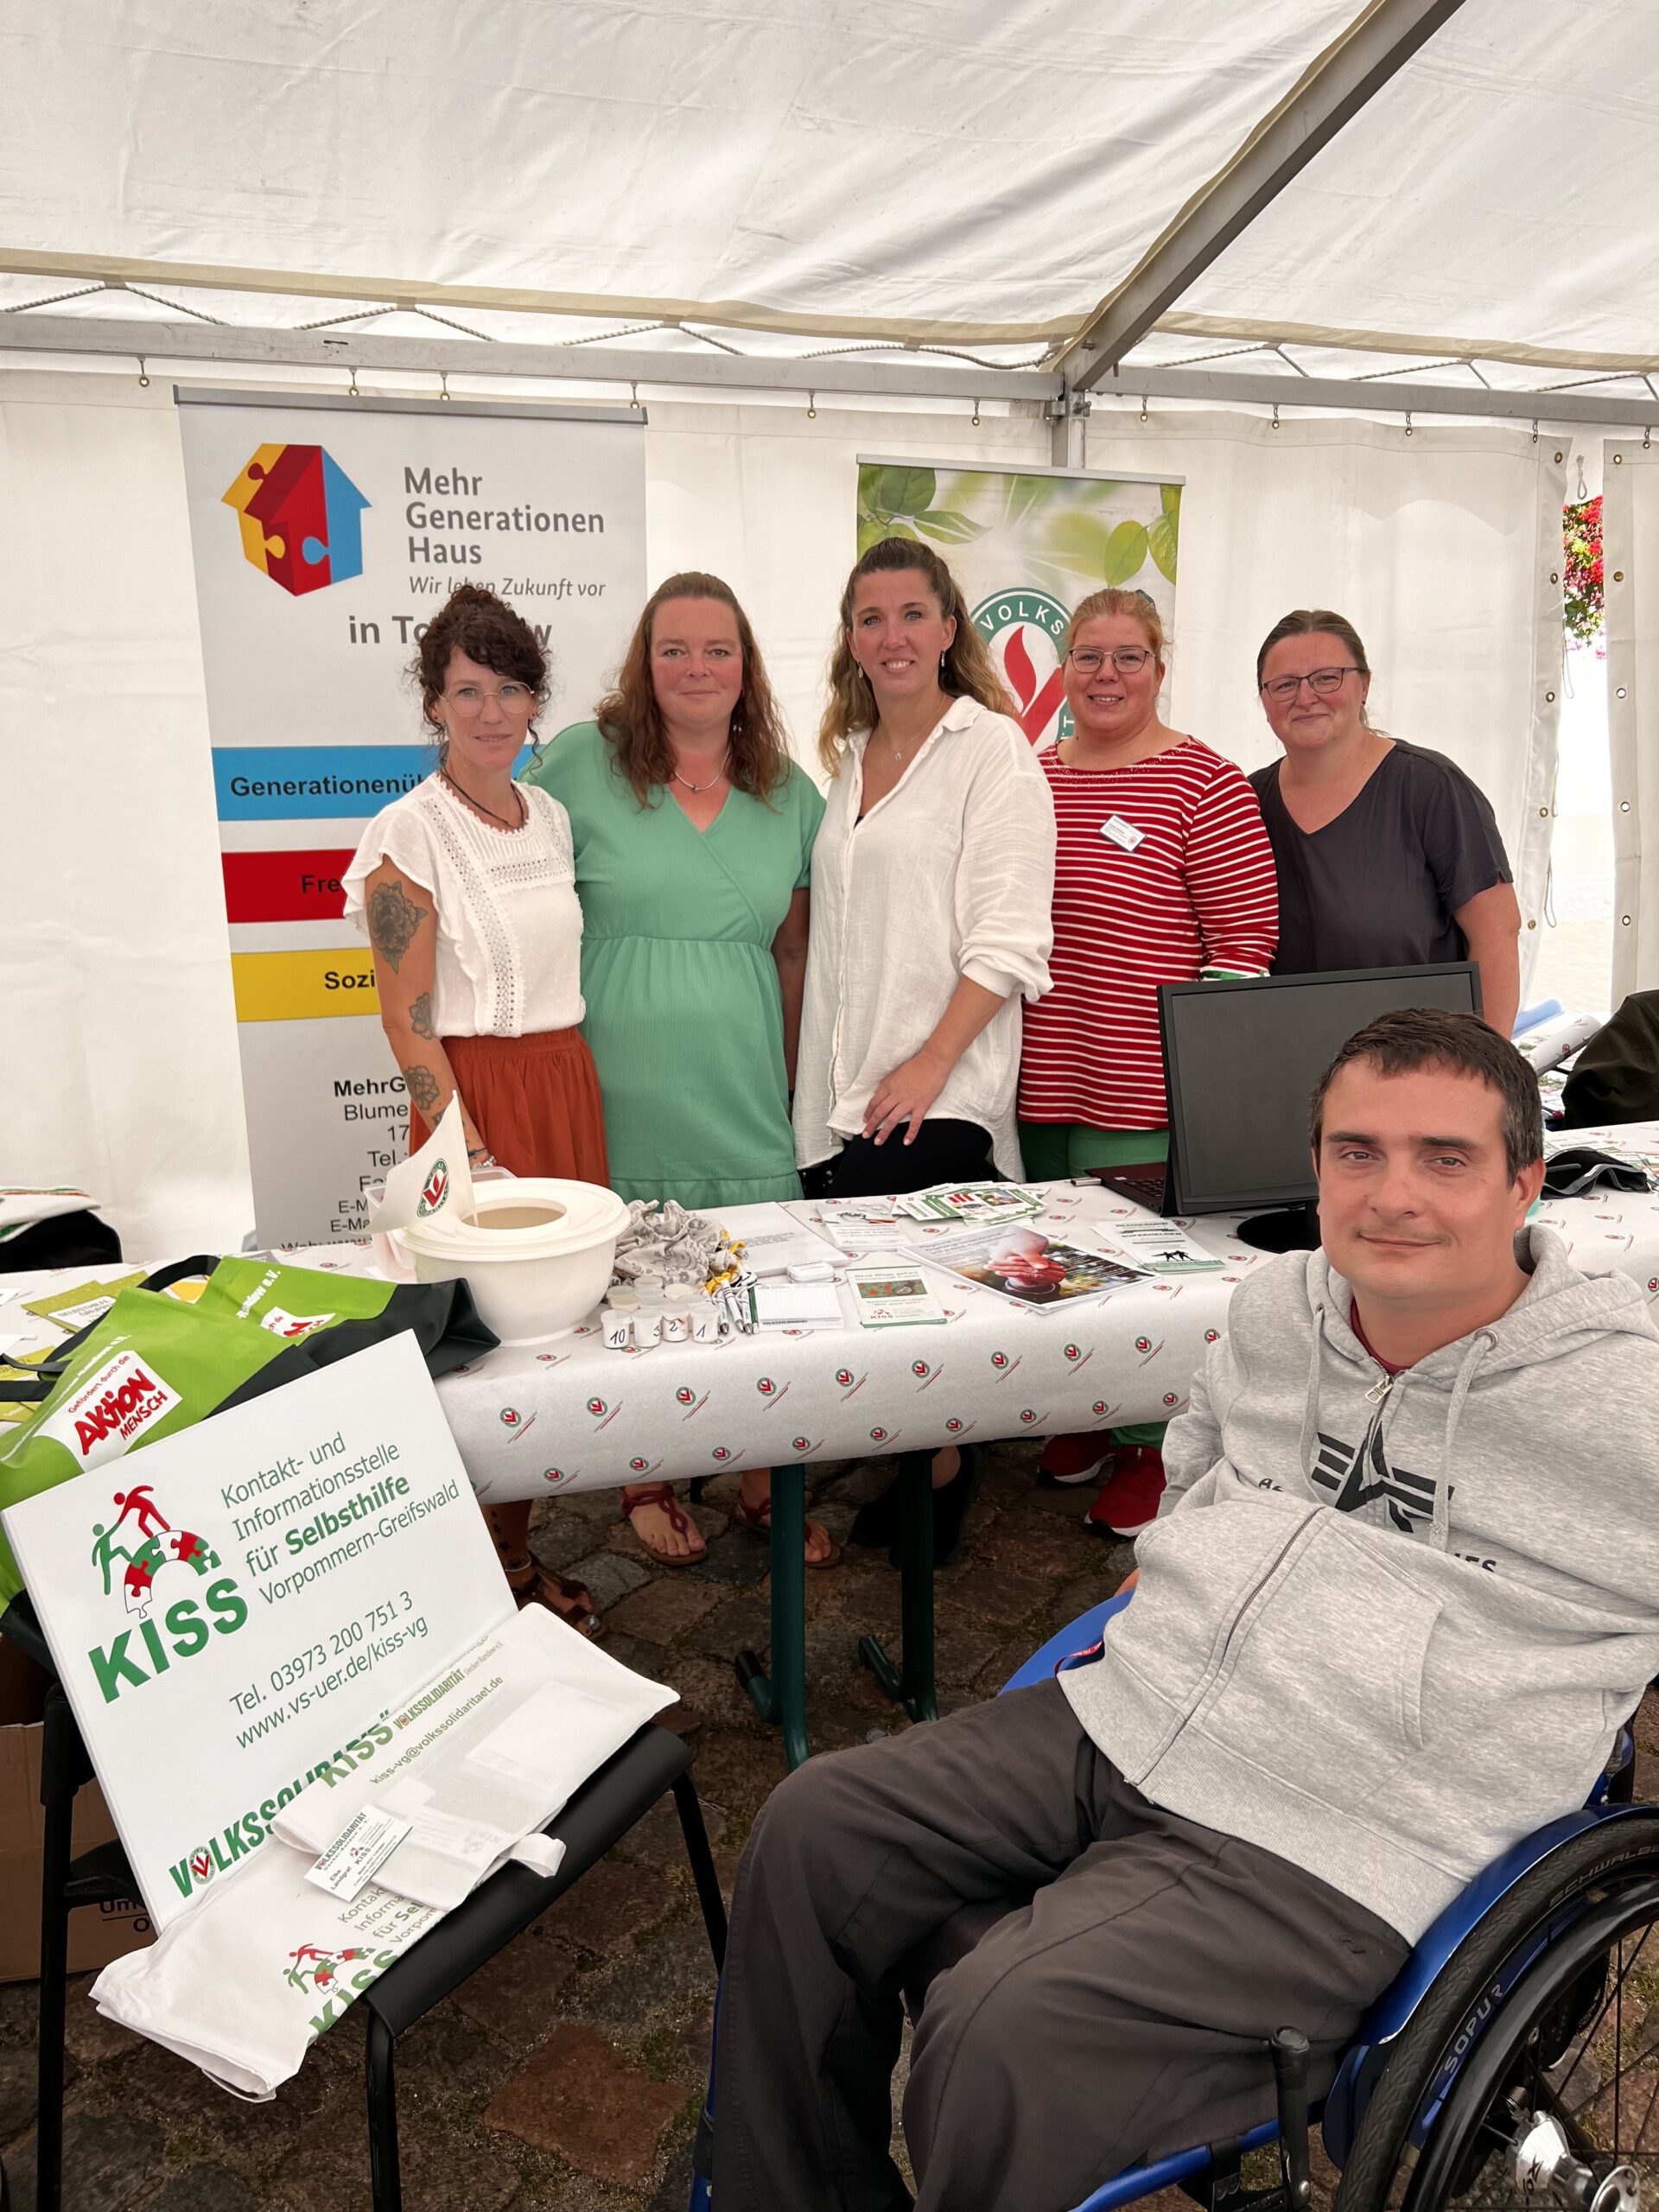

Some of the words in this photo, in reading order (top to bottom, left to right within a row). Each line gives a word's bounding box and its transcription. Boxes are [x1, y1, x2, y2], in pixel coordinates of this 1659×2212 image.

[404, 467, 482, 495] Mehr
[406, 501, 604, 533] Generationen
[409, 536, 482, 564] Haus
[410, 575, 442, 594] Wir
[501, 577, 574, 601] Zukunft
[577, 583, 606, 597] vor
[349, 615, 380, 644] in
[980, 601, 1065, 635] VOLKS
[302, 874, 346, 893] Fre
[325, 969, 376, 989] Sozi
[334, 1077, 406, 1097] MehrG
[344, 1103, 408, 1121] Blume
[388, 1125, 410, 1141] 17
[610, 1328, 626, 1344] 10
[119, 1389, 168, 1440] MENSCH
[221, 1457, 303, 1509] Kontakt-
[309, 1431, 346, 1465] und
[232, 1443, 400, 1541] Informationsstelle
[245, 1544, 278, 1577] für
[285, 1475, 410, 1555] Selbsthilfe
[259, 1479, 460, 1605] Vorpommern-Greifswald
[88, 1578, 248, 1704] KISS
[229, 1684, 267, 1715] Tel.
[270, 1643, 327, 1692] 03973
[329, 1621, 363, 1656] 200
[365, 1599, 398, 1632] 751
[400, 1590, 413, 1611] 3
[236, 1616, 429, 1750] www.vs-uer.de/kiss-vg
[393, 1669, 466, 1731] VOLKSSOLIDARITÄT
[370, 1675, 504, 1785] kiss-vg@volkssolidaritaet.de
[372, 1918, 397, 1940] für
[1444, 1983, 1503, 2074] SOPUR
